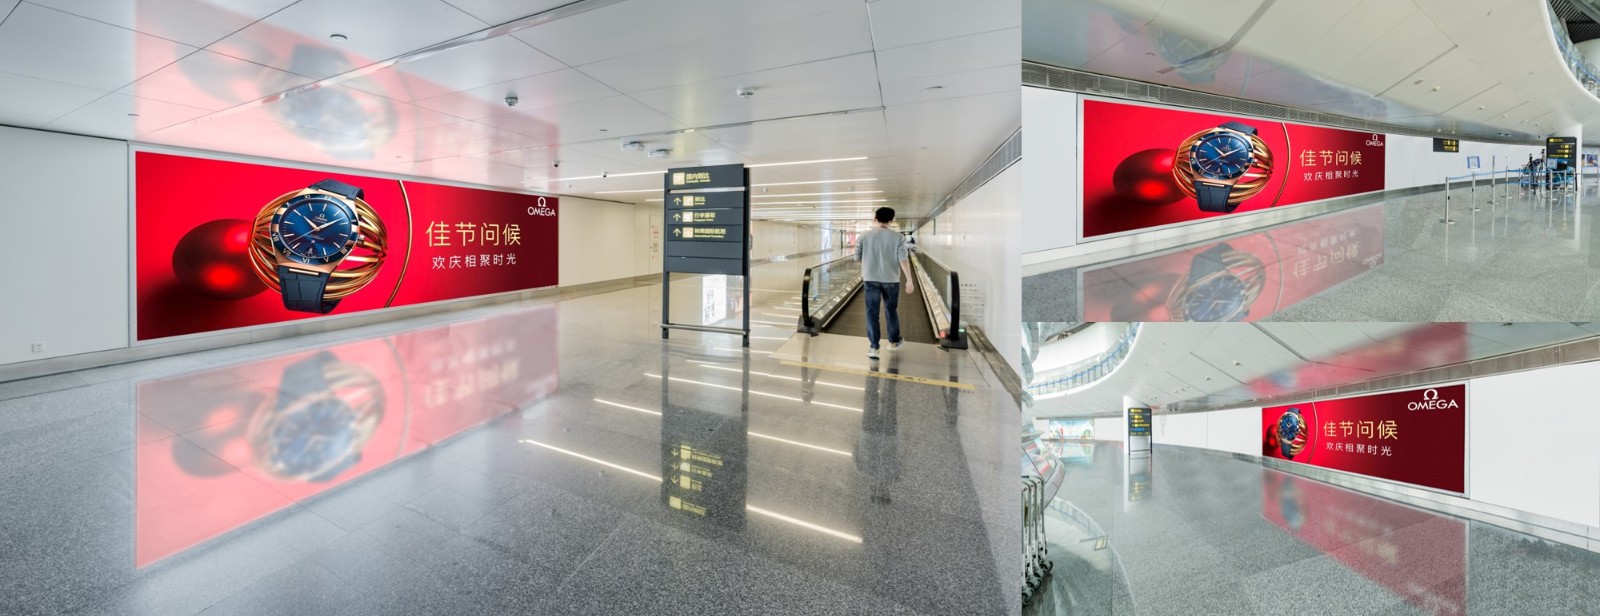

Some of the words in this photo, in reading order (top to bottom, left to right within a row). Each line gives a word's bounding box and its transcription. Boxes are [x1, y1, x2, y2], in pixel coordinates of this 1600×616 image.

[1365, 139, 1384, 147] OMEGA
[1299, 149, 1362, 167] 佳节问候
[1303, 170, 1359, 182] 欢庆相聚时光
[527, 206, 556, 217] OMEGA
[425, 220, 521, 247] 佳节问候
[431, 252, 517, 269] 欢庆相聚时光
[1407, 399, 1459, 411] OMEGA
[1323, 420, 1398, 440] 佳节问候
[1326, 442, 1392, 456] 欢庆相聚时光
